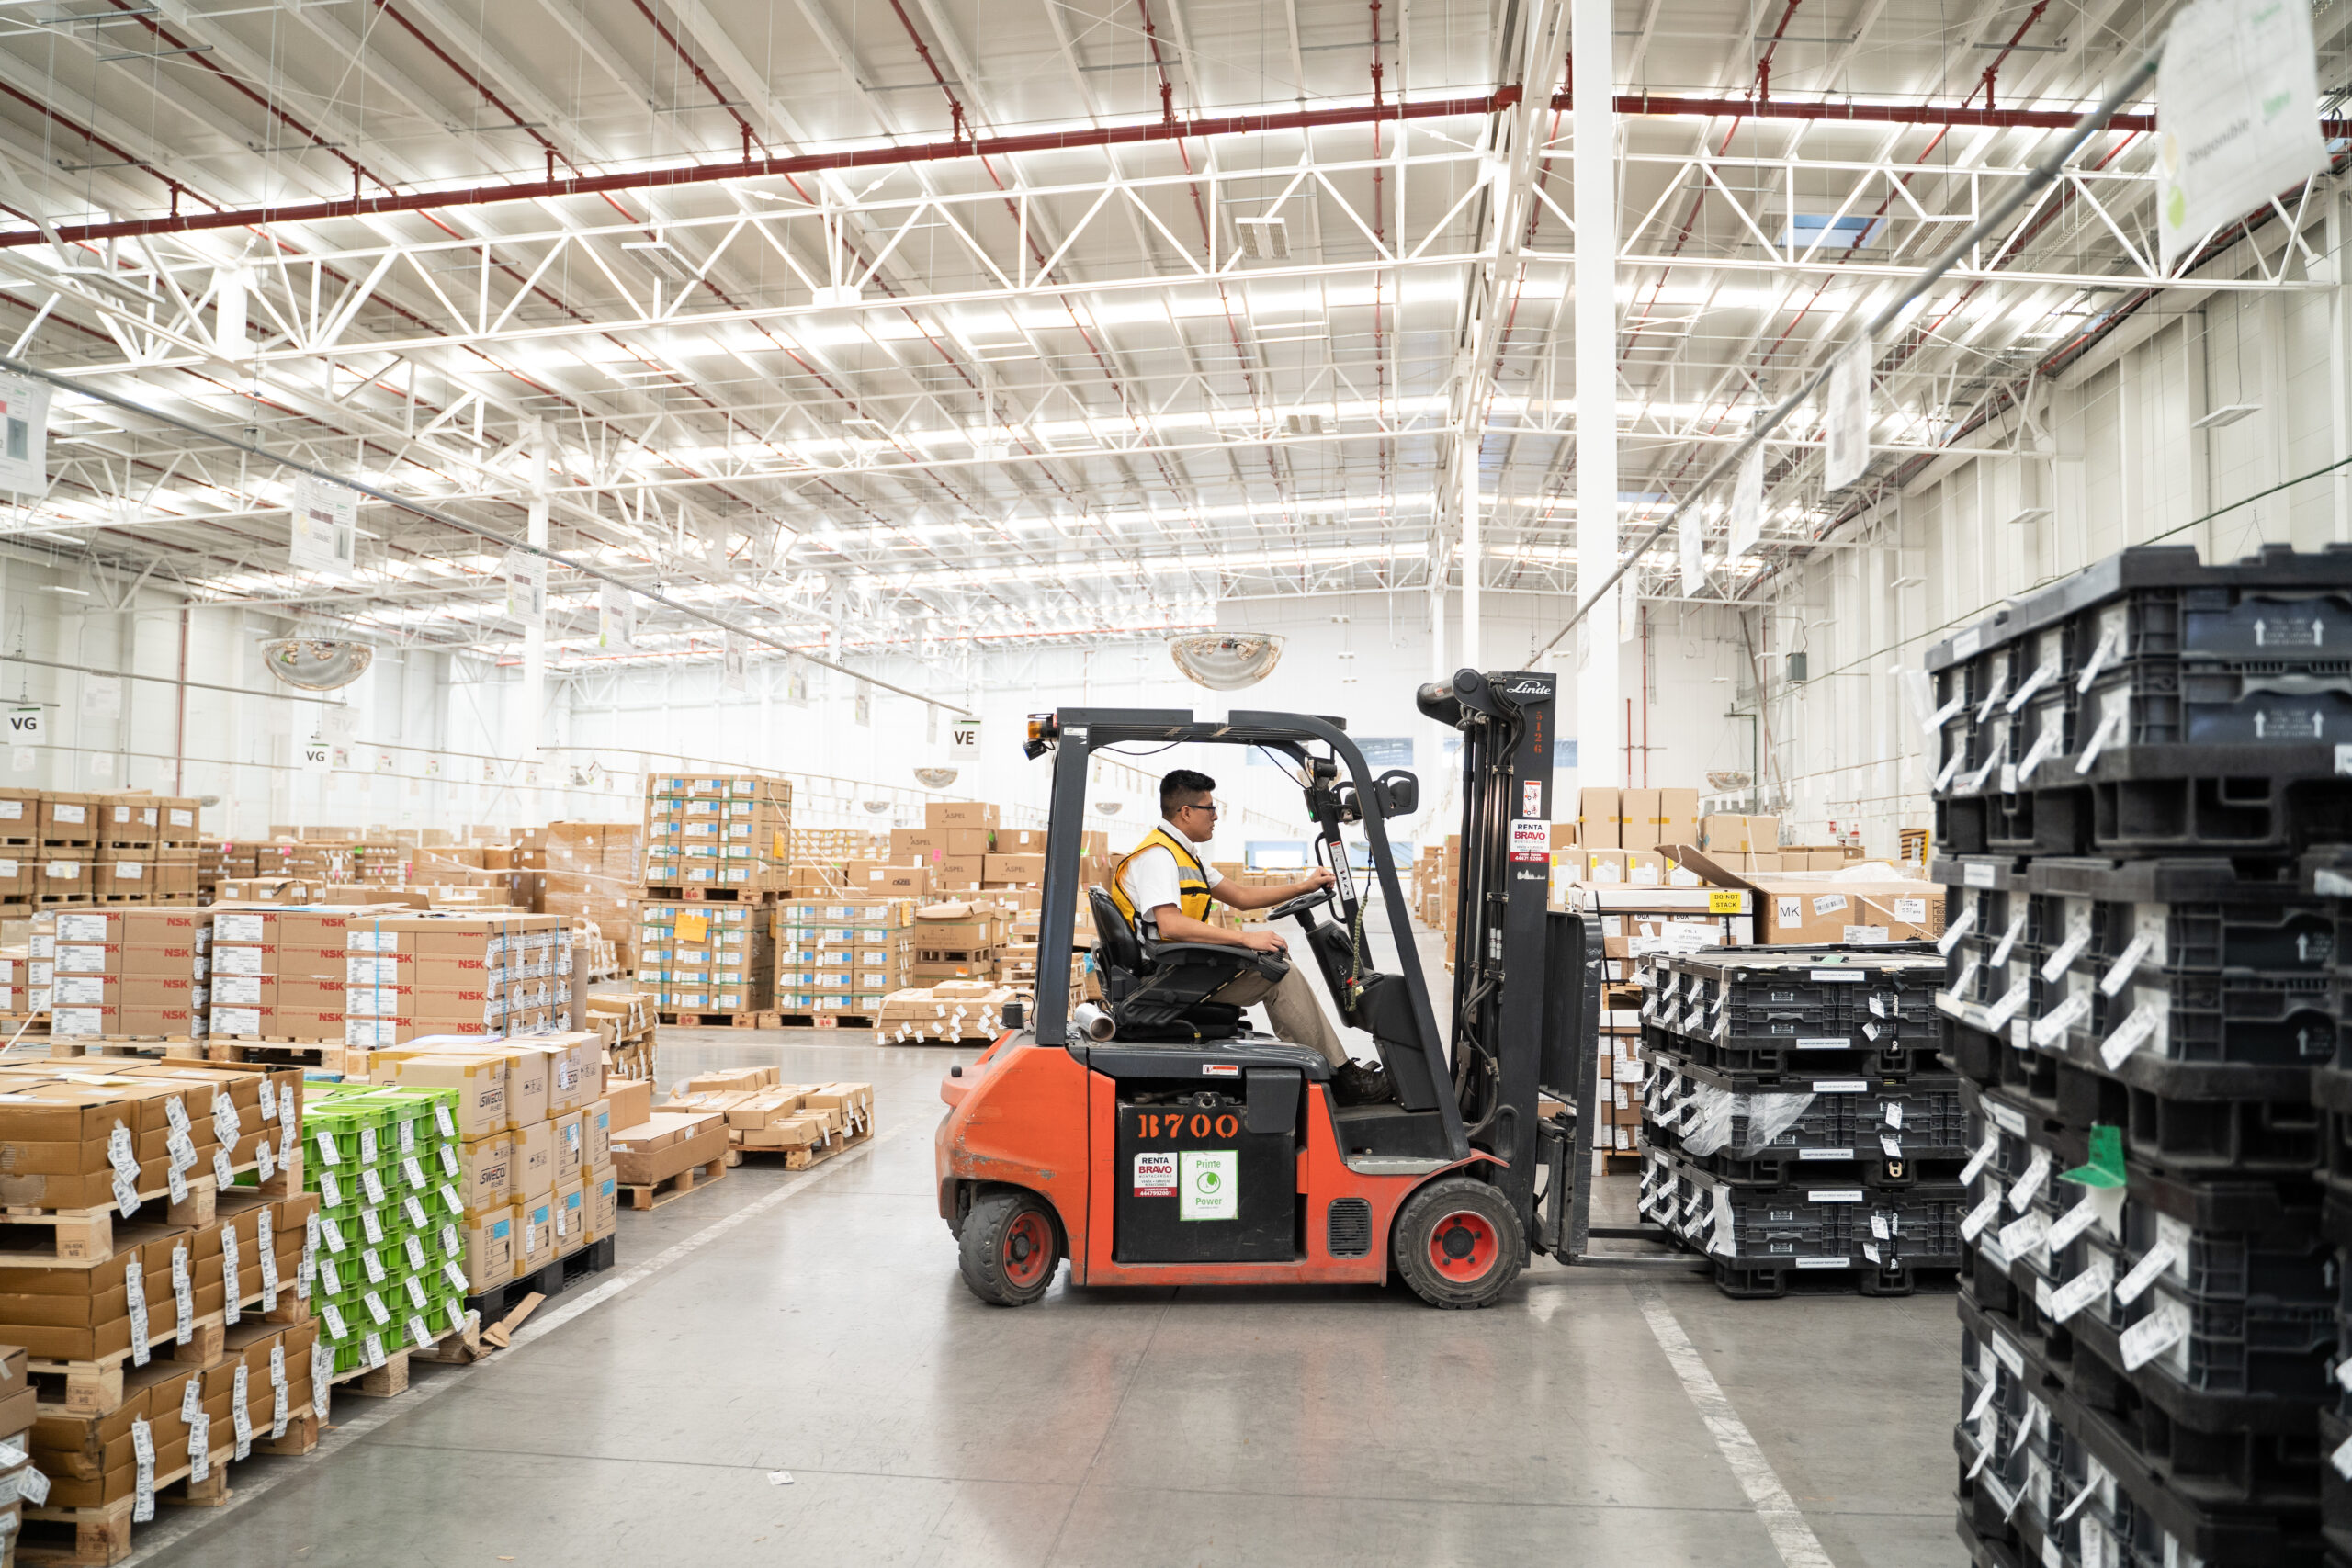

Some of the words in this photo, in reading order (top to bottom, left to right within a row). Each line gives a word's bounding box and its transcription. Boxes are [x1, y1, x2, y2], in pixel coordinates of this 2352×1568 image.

[1506, 680, 1551, 694] Linde
[10, 717, 38, 731] VG
[953, 731, 975, 745] VE
[306, 751, 325, 761] VG
[1514, 831, 1545, 840] BRAVO
[1780, 907, 1800, 917] MK
[97, 913, 121, 921] SK
[167, 917, 192, 926] NSK
[253, 914, 277, 922] SK
[322, 918, 346, 927] NSK
[95, 944, 119, 953] SK
[164, 948, 189, 957] NSK
[252, 945, 275, 953] SK
[320, 950, 345, 958] NSK
[459, 960, 484, 969] NSK
[94, 976, 118, 984] SK
[163, 980, 188, 988] NSK
[250, 976, 275, 984] SK
[319, 982, 344, 991] NSK
[459, 992, 484, 1001] NSK
[93, 1006, 116, 1015] SK
[162, 1011, 188, 1019] NSK
[249, 1007, 273, 1015] SK
[319, 1013, 343, 1022] NSK
[457, 1023, 483, 1032] NSK
[480, 1090, 503, 1108] SWECO
[1138, 1114, 1239, 1139] B700
[1196, 1159, 1221, 1168] Prime
[1139, 1166, 1172, 1174] BRAVO
[480, 1167, 506, 1185] SWECO
[1196, 1197, 1222, 1205] Power
